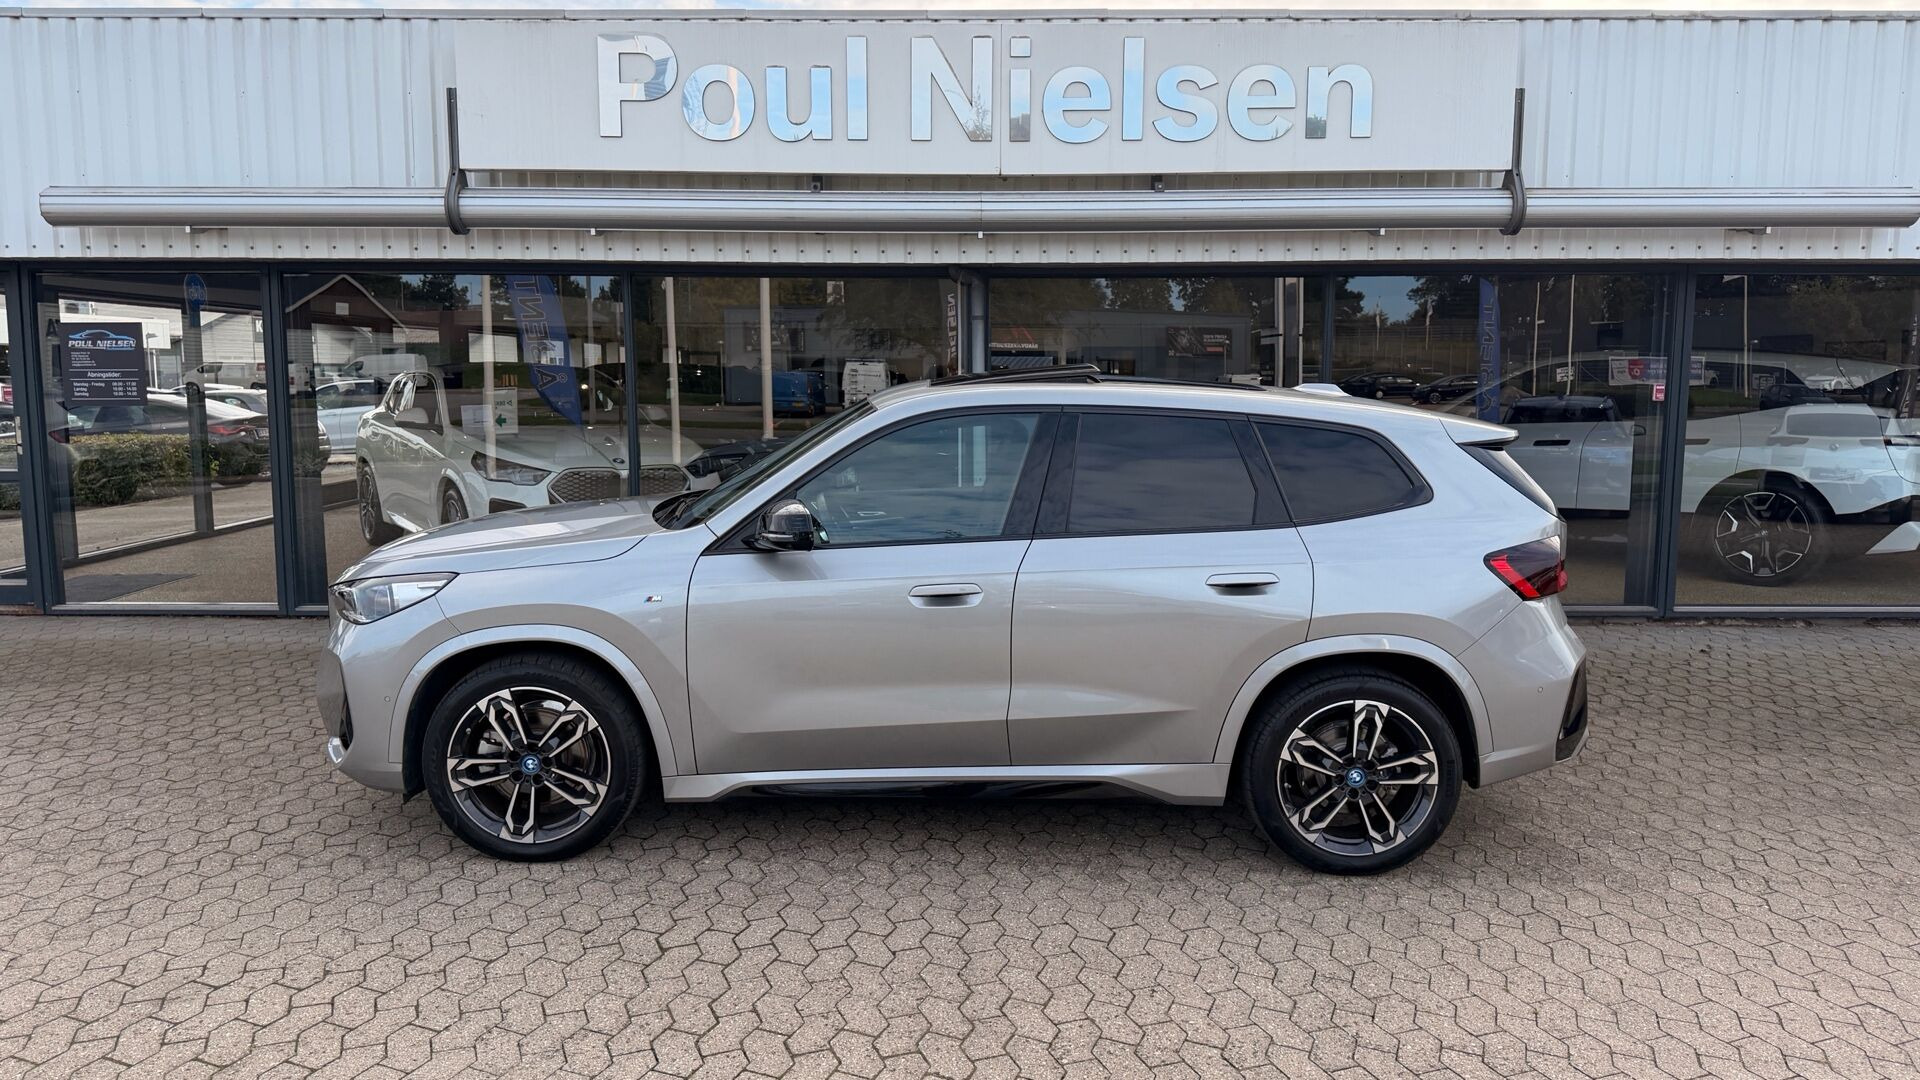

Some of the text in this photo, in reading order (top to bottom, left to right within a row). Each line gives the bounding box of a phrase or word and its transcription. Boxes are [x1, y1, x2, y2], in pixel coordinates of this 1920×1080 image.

[597, 31, 1374, 144] Poul Nielsen
[67, 340, 136, 348] POUL NIELSEN
